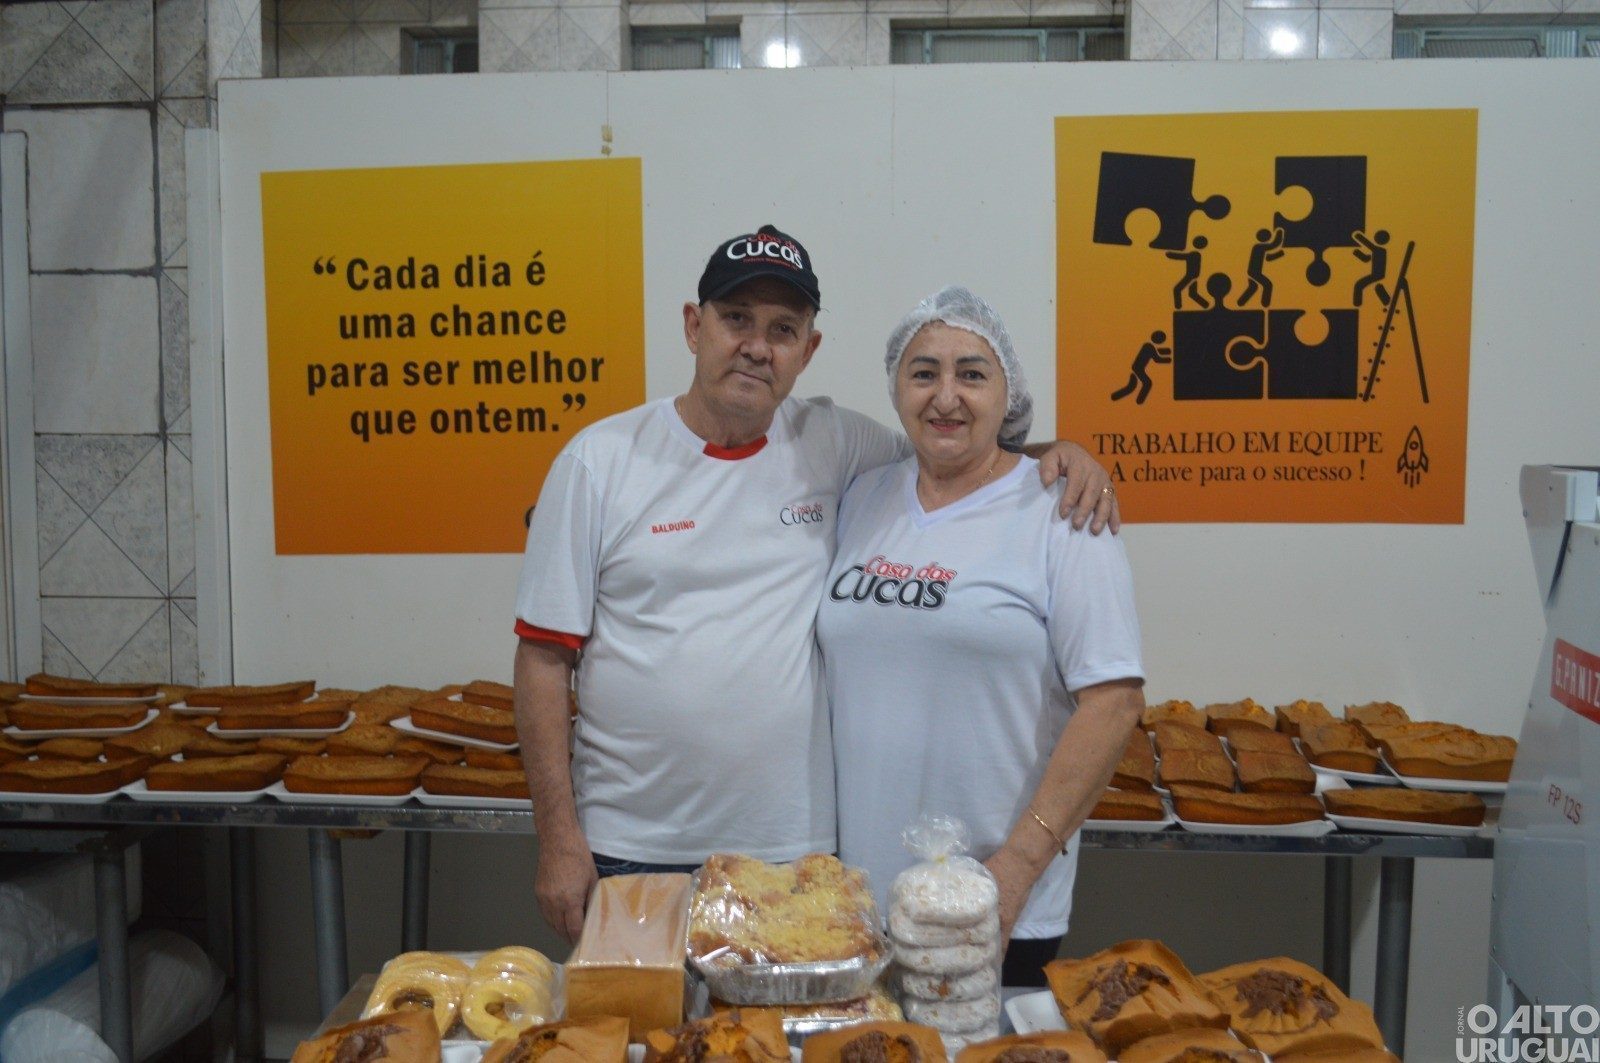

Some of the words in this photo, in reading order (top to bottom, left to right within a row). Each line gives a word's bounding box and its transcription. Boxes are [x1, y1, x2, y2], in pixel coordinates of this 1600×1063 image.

[454, 255, 511, 288] dia
[526, 250, 546, 286] é
[339, 313, 416, 339] uma
[430, 304, 567, 338] chance
[307, 361, 389, 395] para
[403, 360, 459, 386] ser
[473, 351, 604, 385] melhor
[350, 409, 417, 442] que
[1092, 431, 1236, 456] TRABALHO
[1242, 431, 1280, 454] EM
[1288, 430, 1383, 456] EQUIPE
[1110, 462, 1125, 482] A
[1133, 460, 1193, 482] chave
[1200, 466, 1247, 486] para
[1252, 468, 1266, 481] o
[1273, 466, 1352, 482] sucesso
[651, 521, 695, 534] BALDUINO
[864, 555, 912, 579] Casa
[917, 562, 957, 581] das
